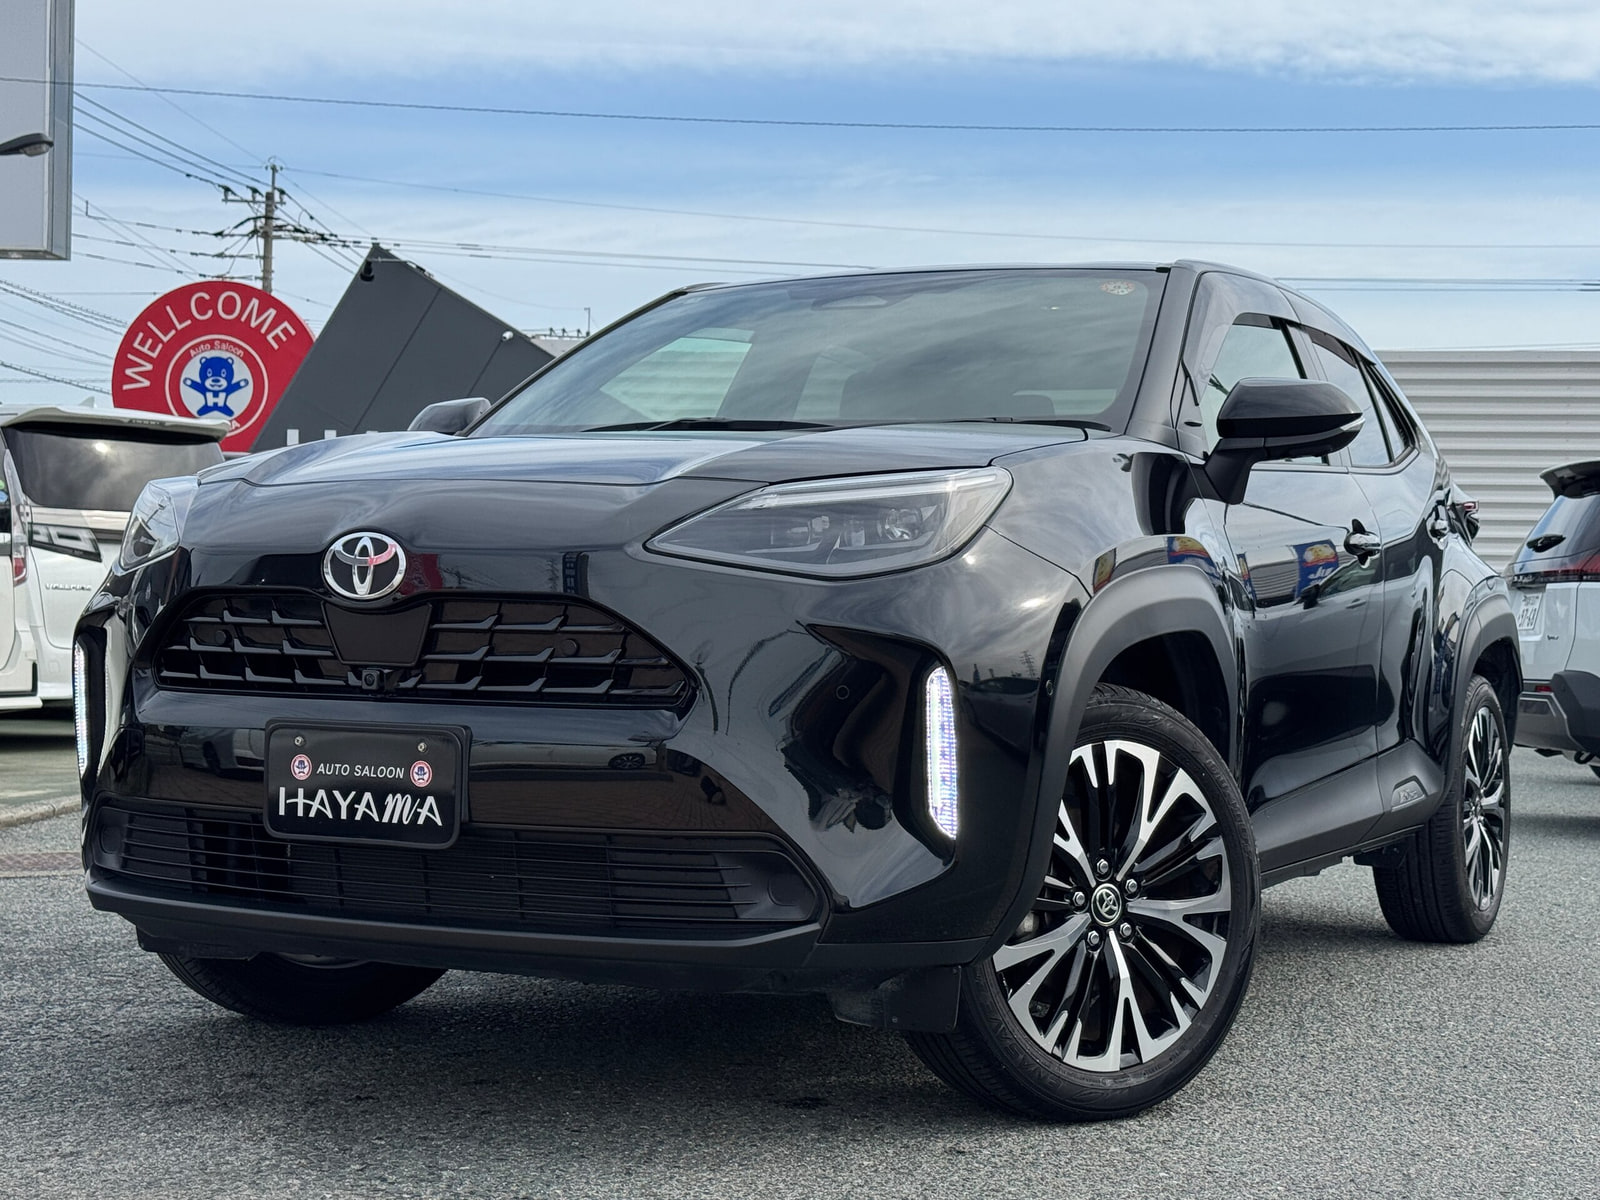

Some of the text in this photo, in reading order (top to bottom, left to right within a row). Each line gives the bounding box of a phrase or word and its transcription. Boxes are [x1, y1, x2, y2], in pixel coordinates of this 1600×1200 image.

[122, 291, 297, 390] WELLCOME
[189, 340, 245, 358] Auto Saloon
[205, 392, 227, 407] H
[316, 763, 405, 779] AUTO SALOON
[278, 786, 443, 826] HAYAMA
